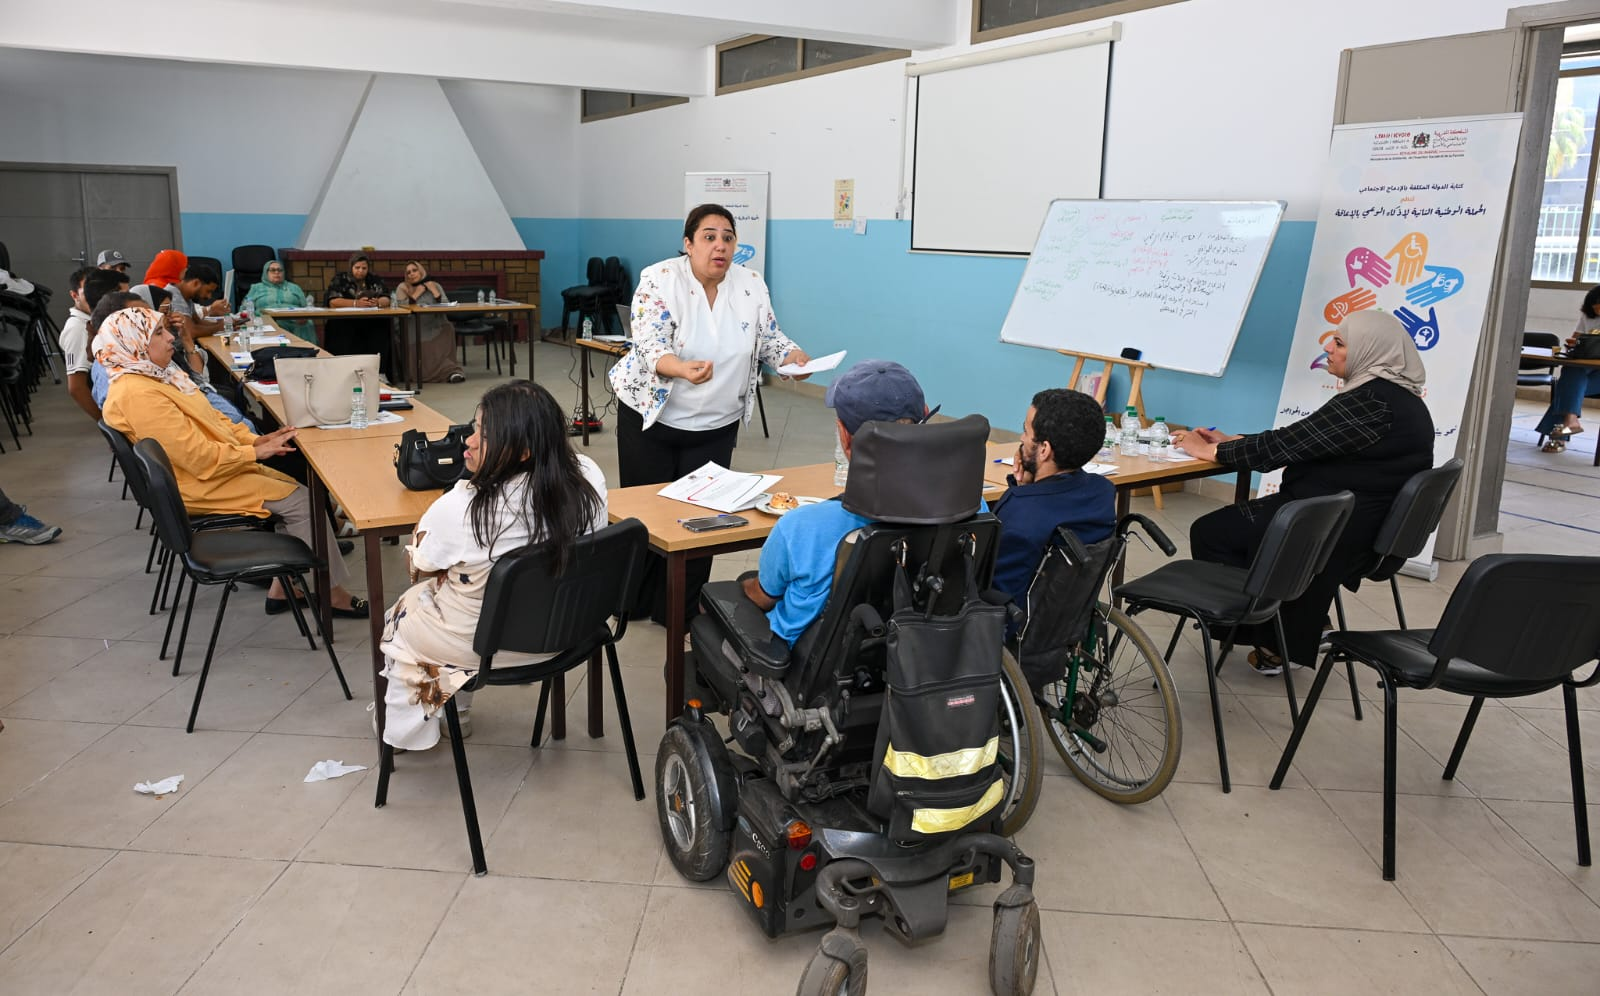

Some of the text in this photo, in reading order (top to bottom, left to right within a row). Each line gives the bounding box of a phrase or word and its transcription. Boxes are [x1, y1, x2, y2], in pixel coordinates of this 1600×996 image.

[1362, 206, 1385, 218] الوعي
[1411, 208, 1433, 218] الثانية
[1434, 205, 1463, 218] الوطنية
[1464, 203, 1486, 216] الحملة
